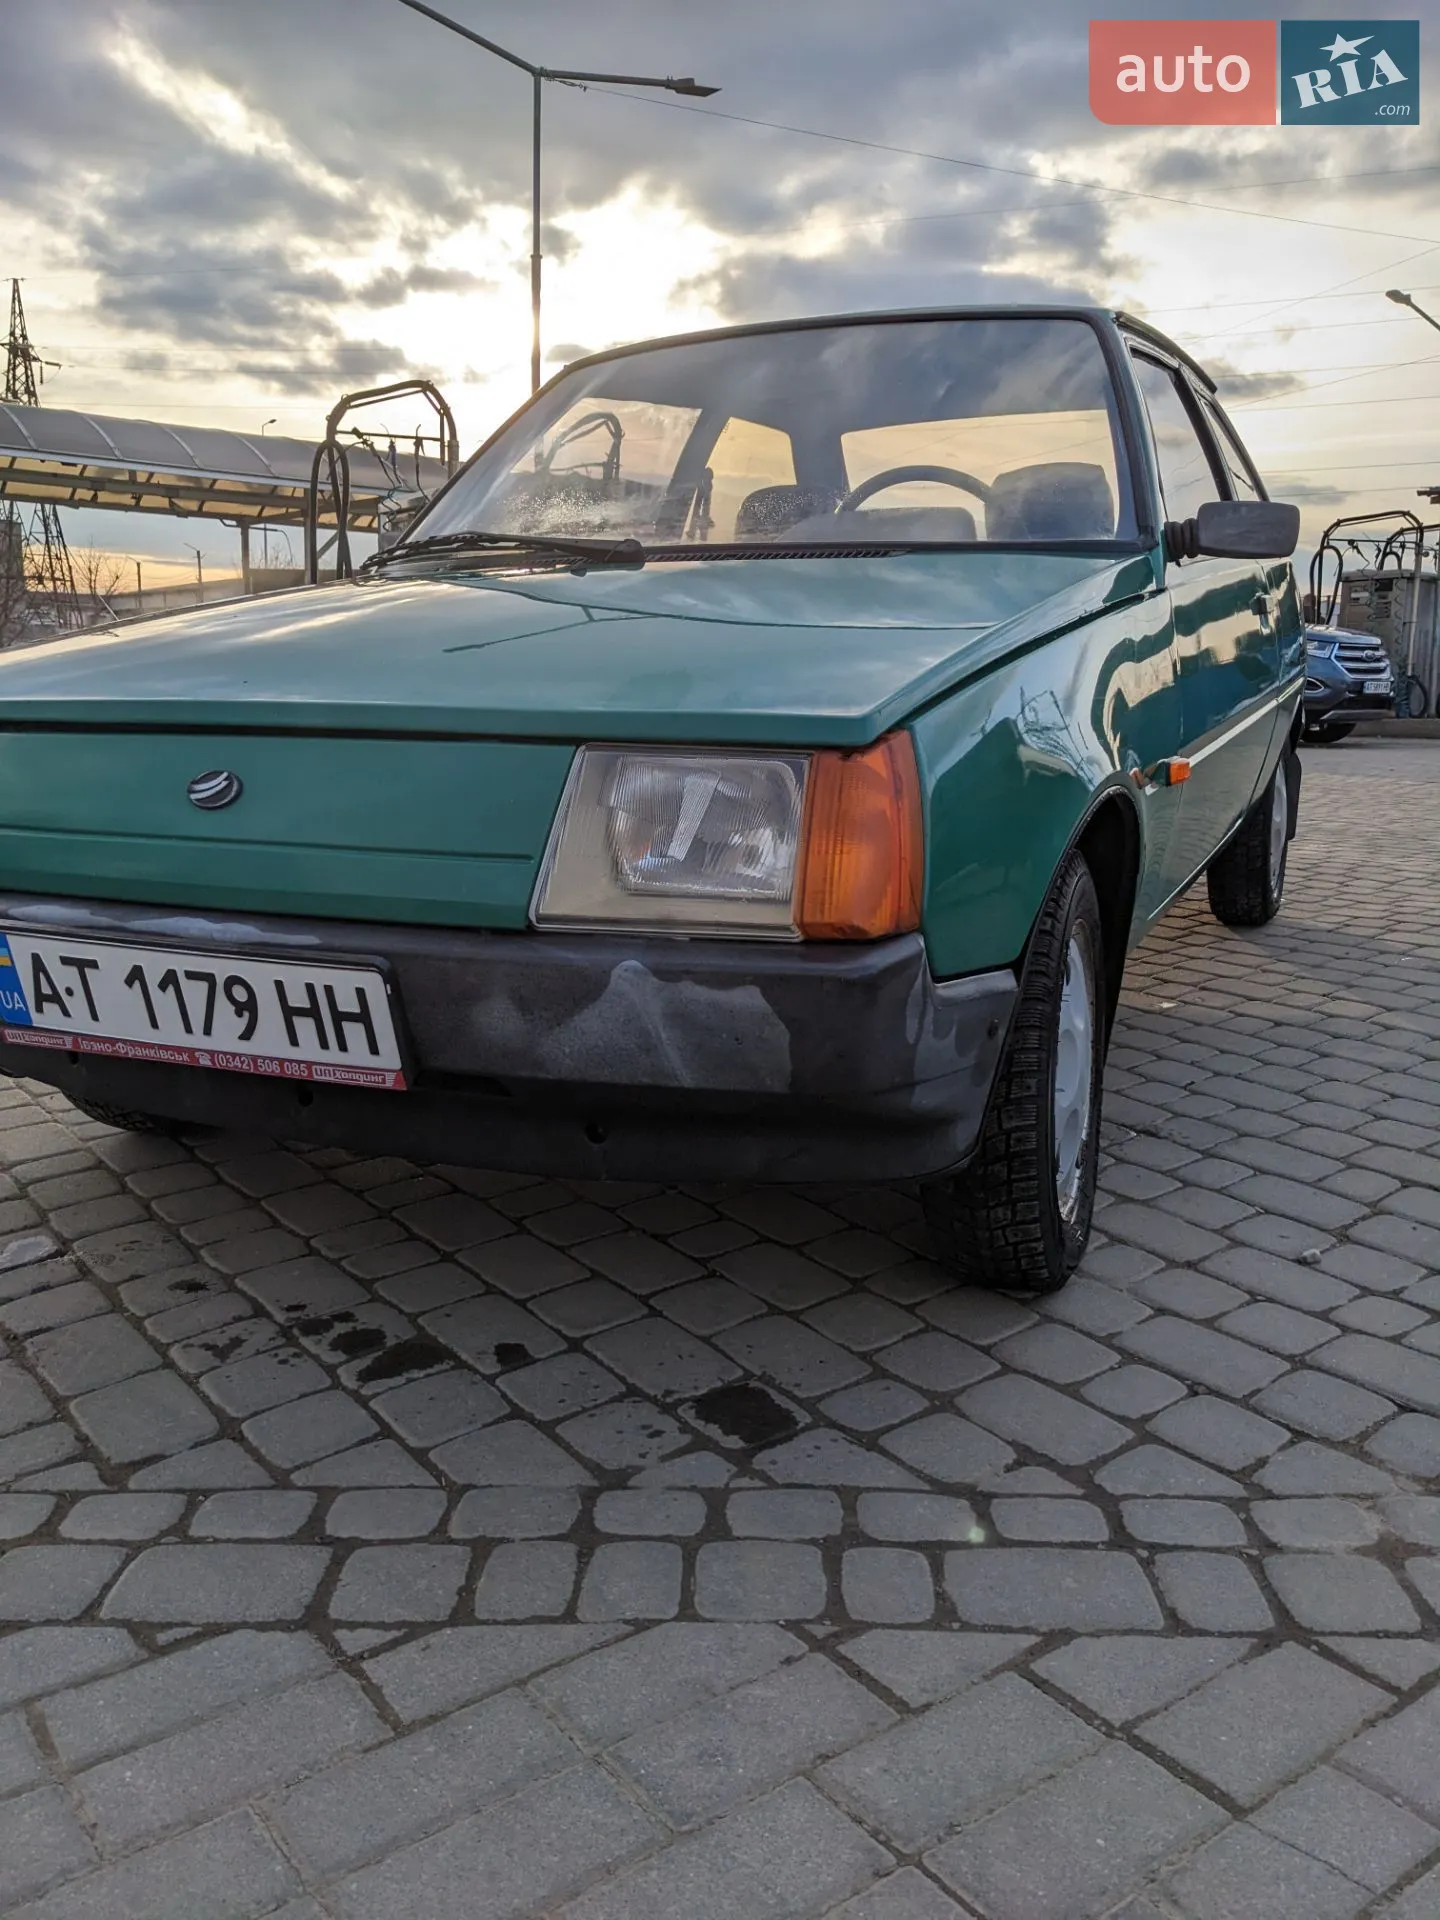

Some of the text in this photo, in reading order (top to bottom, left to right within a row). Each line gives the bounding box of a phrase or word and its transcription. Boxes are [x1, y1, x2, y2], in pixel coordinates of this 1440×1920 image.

[0, 990, 26, 1011] UA
[124, 964, 258, 1041] 1179
[274, 979, 380, 1056] HH
[214, 1053, 253, 1073] (0342)
[257, 1059, 280, 1074] 506
[284, 1061, 308, 1077] 085
